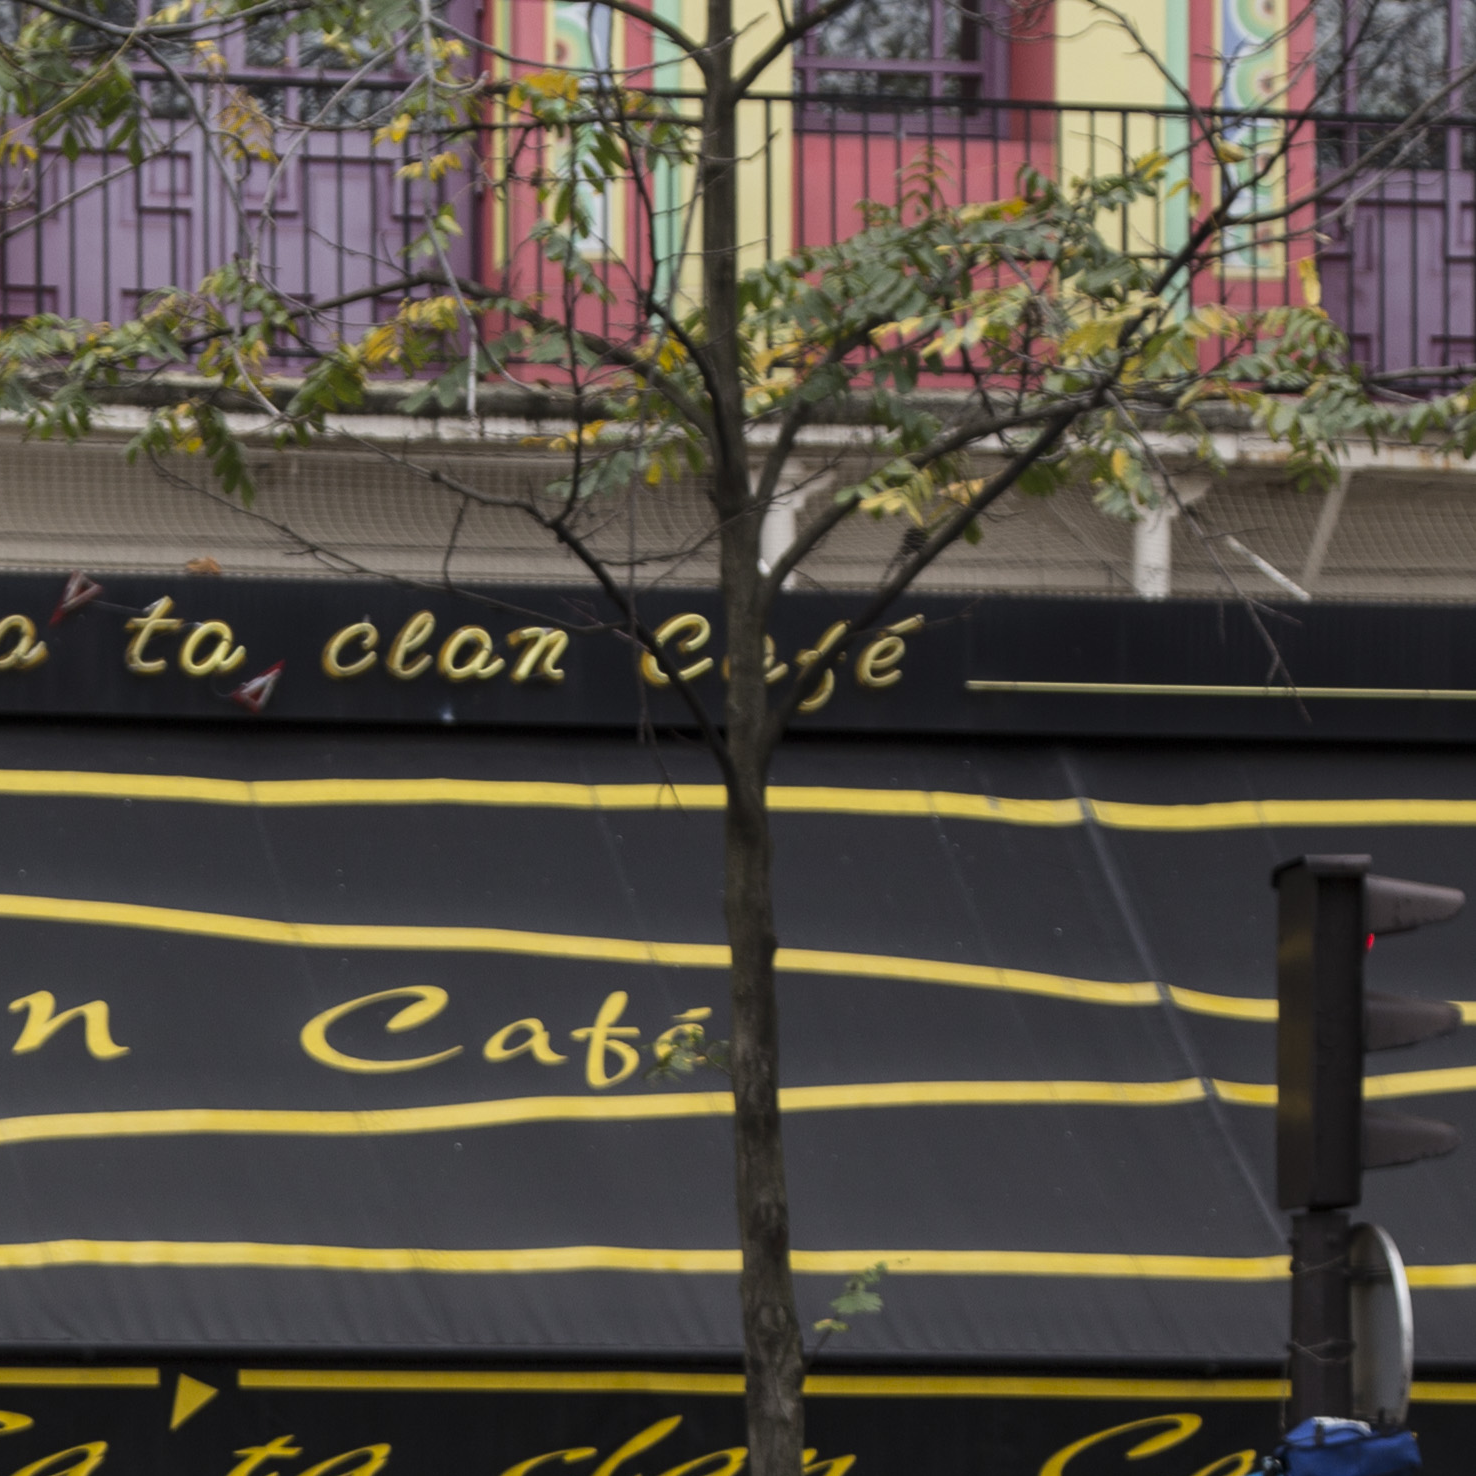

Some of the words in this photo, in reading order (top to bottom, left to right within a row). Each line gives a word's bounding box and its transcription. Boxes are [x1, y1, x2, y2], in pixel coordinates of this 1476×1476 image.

[123, 595, 247, 676] ta
[321, 612, 566, 682] clan
[300, 984, 714, 1089] Café
